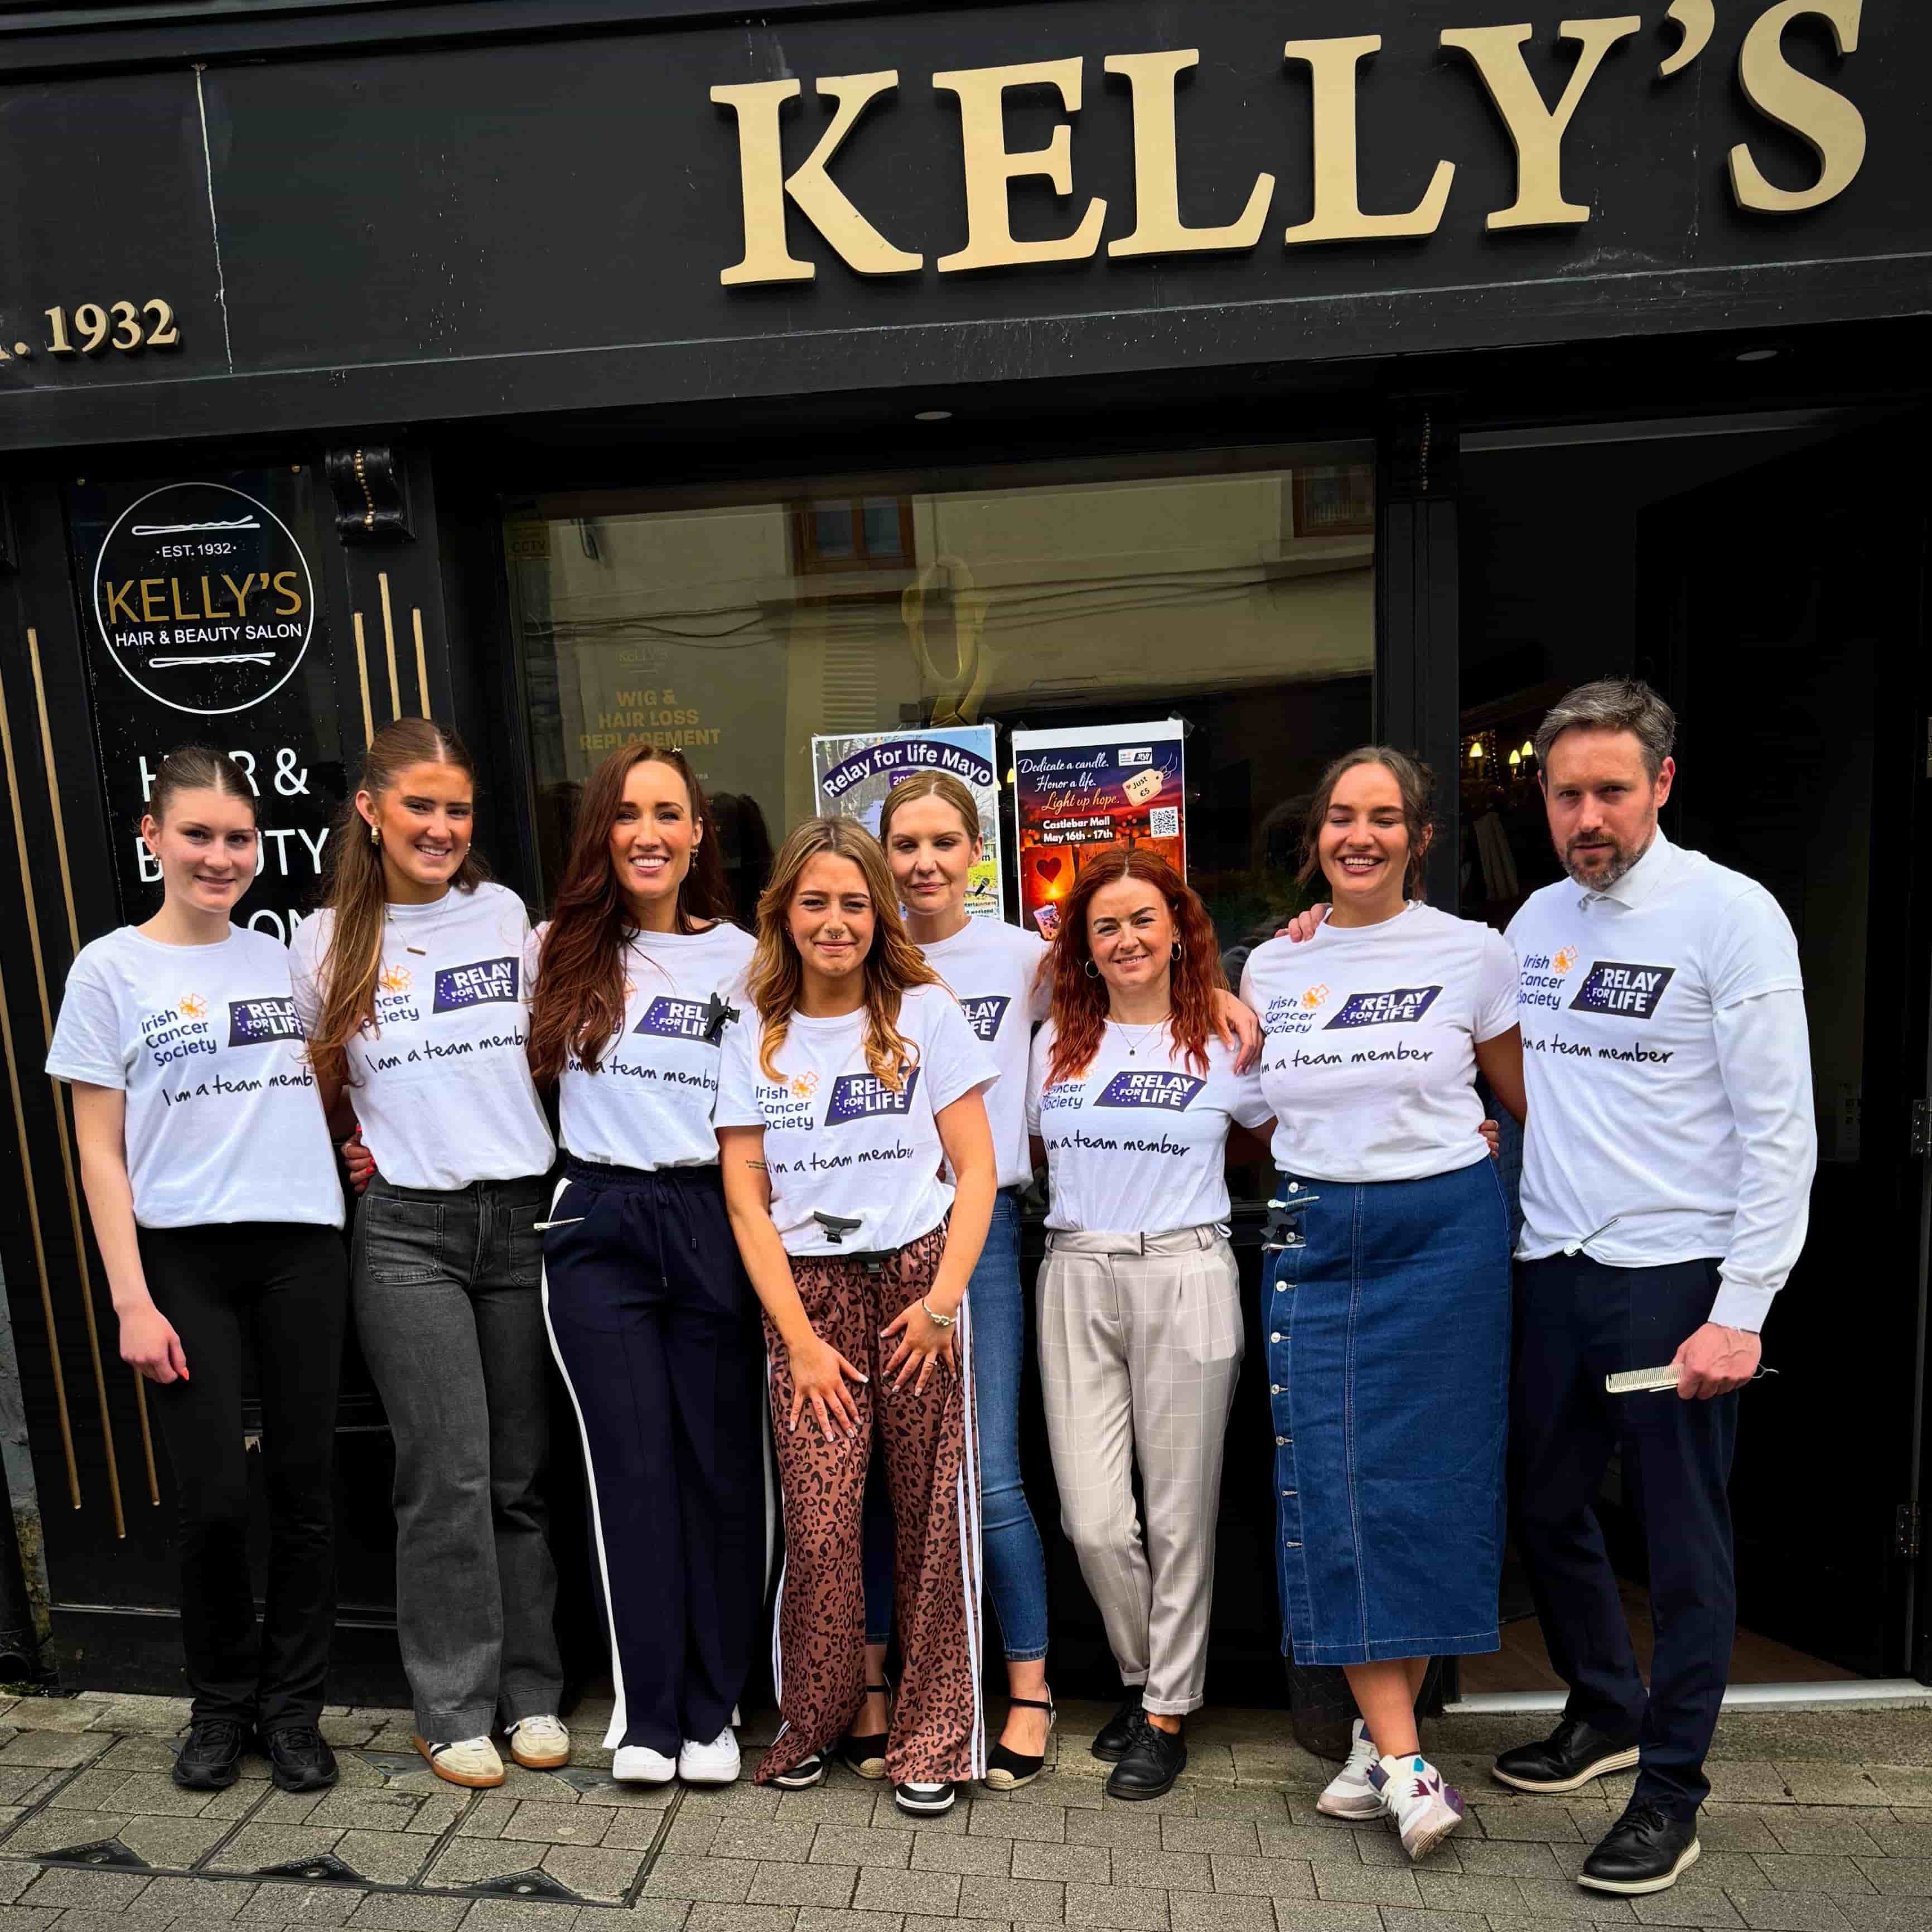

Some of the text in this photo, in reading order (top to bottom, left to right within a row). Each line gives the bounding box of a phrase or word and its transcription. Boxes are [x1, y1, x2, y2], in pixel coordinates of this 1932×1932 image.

[709, 0, 1866, 286] KELLY'S
[45, 298, 180, 352] 1932
[198, 543, 231, 556] 1932
[106, 571, 302, 624] KELLY'S
[115, 623, 302, 647] HAIR & BEAUTY SALON
[616, 688, 679, 707] WIG &
[598, 709, 700, 729] HAIR LOSS
[579, 728, 721, 750] REPLACEMENT
[822, 743, 991, 798] Relay for life Mayo
[1018, 756, 1065, 774] Dedicate
[1075, 752, 1109, 769] candle.
[139, 747, 311, 802] HR &
[1035, 774, 1068, 792] Honor
[1078, 771, 1097, 793] life.
[1041, 788, 1120, 815] Light up hope.
[1043, 816, 1110, 830] Castlebar Mall
[1044, 833, 1063, 844] May
[1065, 830, 1086, 841] 16th
[1093, 829, 1113, 839] 17th
[1523, 954, 1550, 969] Irish
[453, 962, 512, 988] RELAY
[1520, 972, 1566, 989] Cancer
[1602, 968, 1661, 992] RELAY
[451, 981, 514, 999] FOR LIFE
[1361, 990, 1430, 1011] RELAY
[1592, 988, 1649, 1012] FOR LIFE
[247, 1000, 297, 1019] RELA
[669, 1002, 709, 1023] REL
[1268, 996, 1298, 1011] Irish
[1350, 1006, 1416, 1022] FOR LIFE
[142, 1010, 178, 1034] Irish
[247, 1018, 270, 1030] FOR
[361, 1008, 420, 1028] ociety
[659, 1017, 681, 1026] FOR
[1266, 1012, 1316, 1023] Cancer
[145, 1021, 209, 1049] Cancer
[154, 1039, 218, 1067] Society
[378, 1057, 402, 1071] am
[408, 1050, 421, 1062] a
[424, 1040, 473, 1059] team
[1275, 1059, 1287, 1070] a
[1292, 1049, 1342, 1068] team
[1351, 1040, 1433, 1062] member
[1536, 1039, 1546, 1051] a
[1551, 1033, 1592, 1057] team
[1598, 1042, 1674, 1064] member
[196, 1083, 209, 1096] a
[212, 1074, 262, 1094] team
[269, 1066, 313, 1087] memb
[610, 1055, 657, 1079] team
[664, 1069, 719, 1091] membe
[756, 1086, 788, 1099] Irish
[1047, 1083, 1086, 1095] ncer
[1130, 1075, 1195, 1093] RELAY
[843, 1094, 905, 1111] FOR LIFE
[1141, 1089, 1181, 1107] LIFE
[765, 1115, 814, 1131] ociety
[1061, 1136, 1072, 1148] a
[1074, 1129, 1117, 1149] team
[1123, 1133, 1190, 1156] member
[794, 1161, 806, 1172] a
[812, 1152, 852, 1171] team
